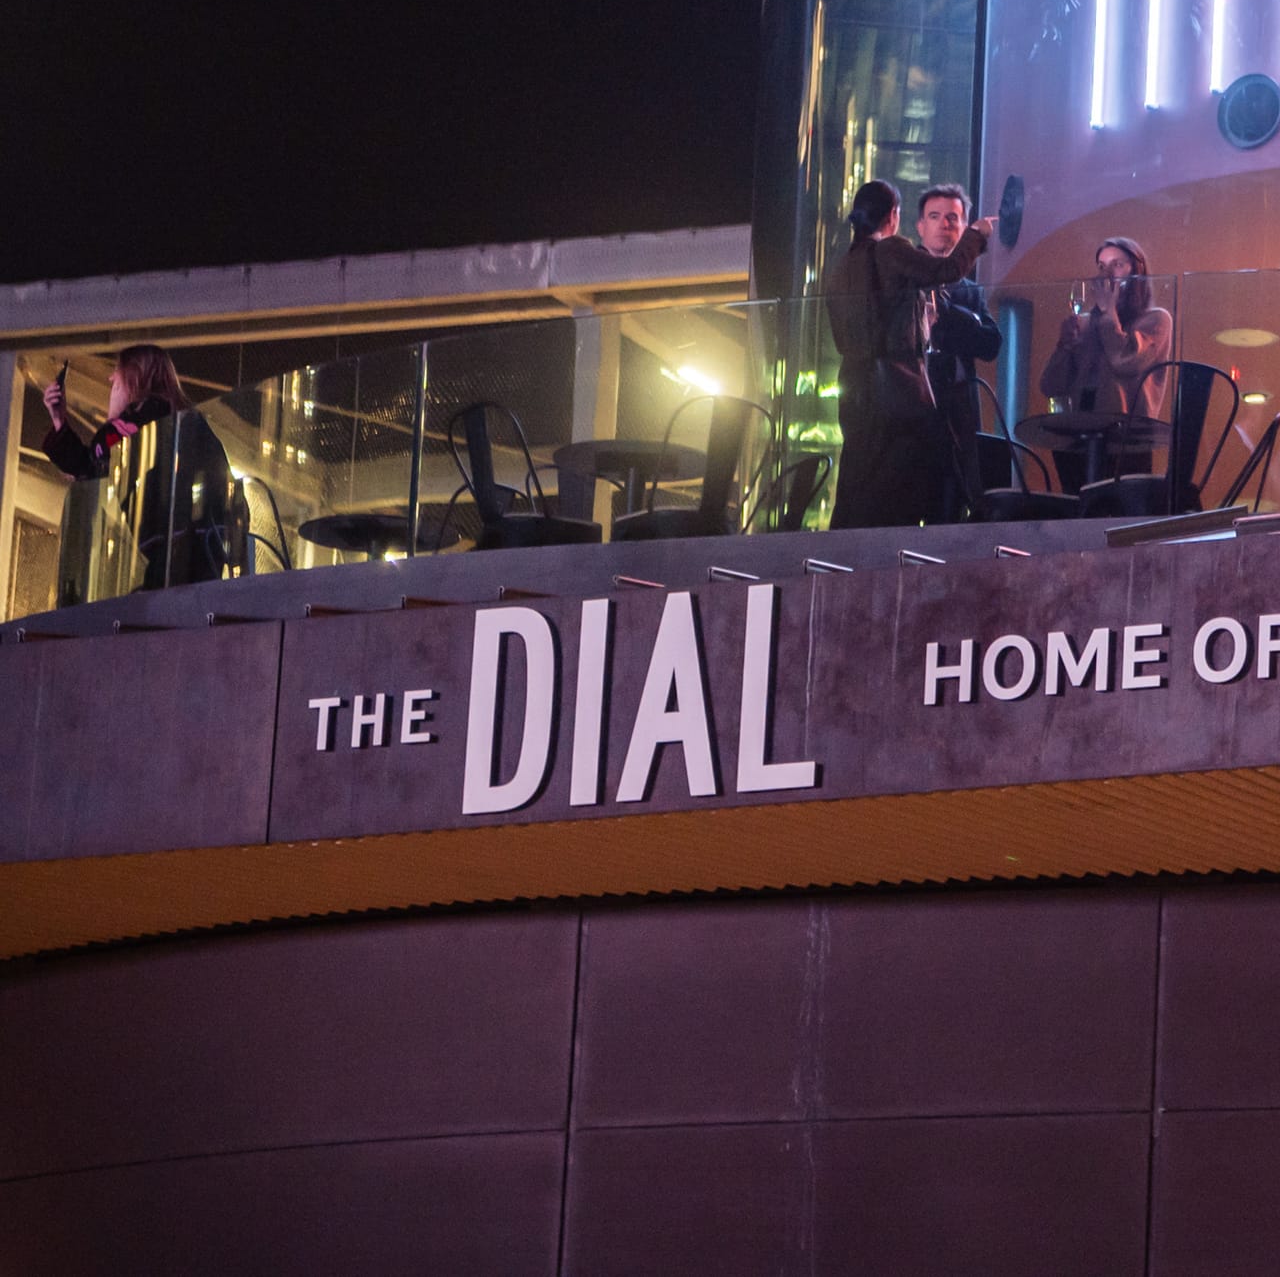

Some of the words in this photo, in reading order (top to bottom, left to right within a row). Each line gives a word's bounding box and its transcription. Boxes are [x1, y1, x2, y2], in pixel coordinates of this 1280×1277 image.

[307, 688, 434, 752] THE
[461, 582, 817, 815] DIAL
[922, 623, 1164, 706] HOME
